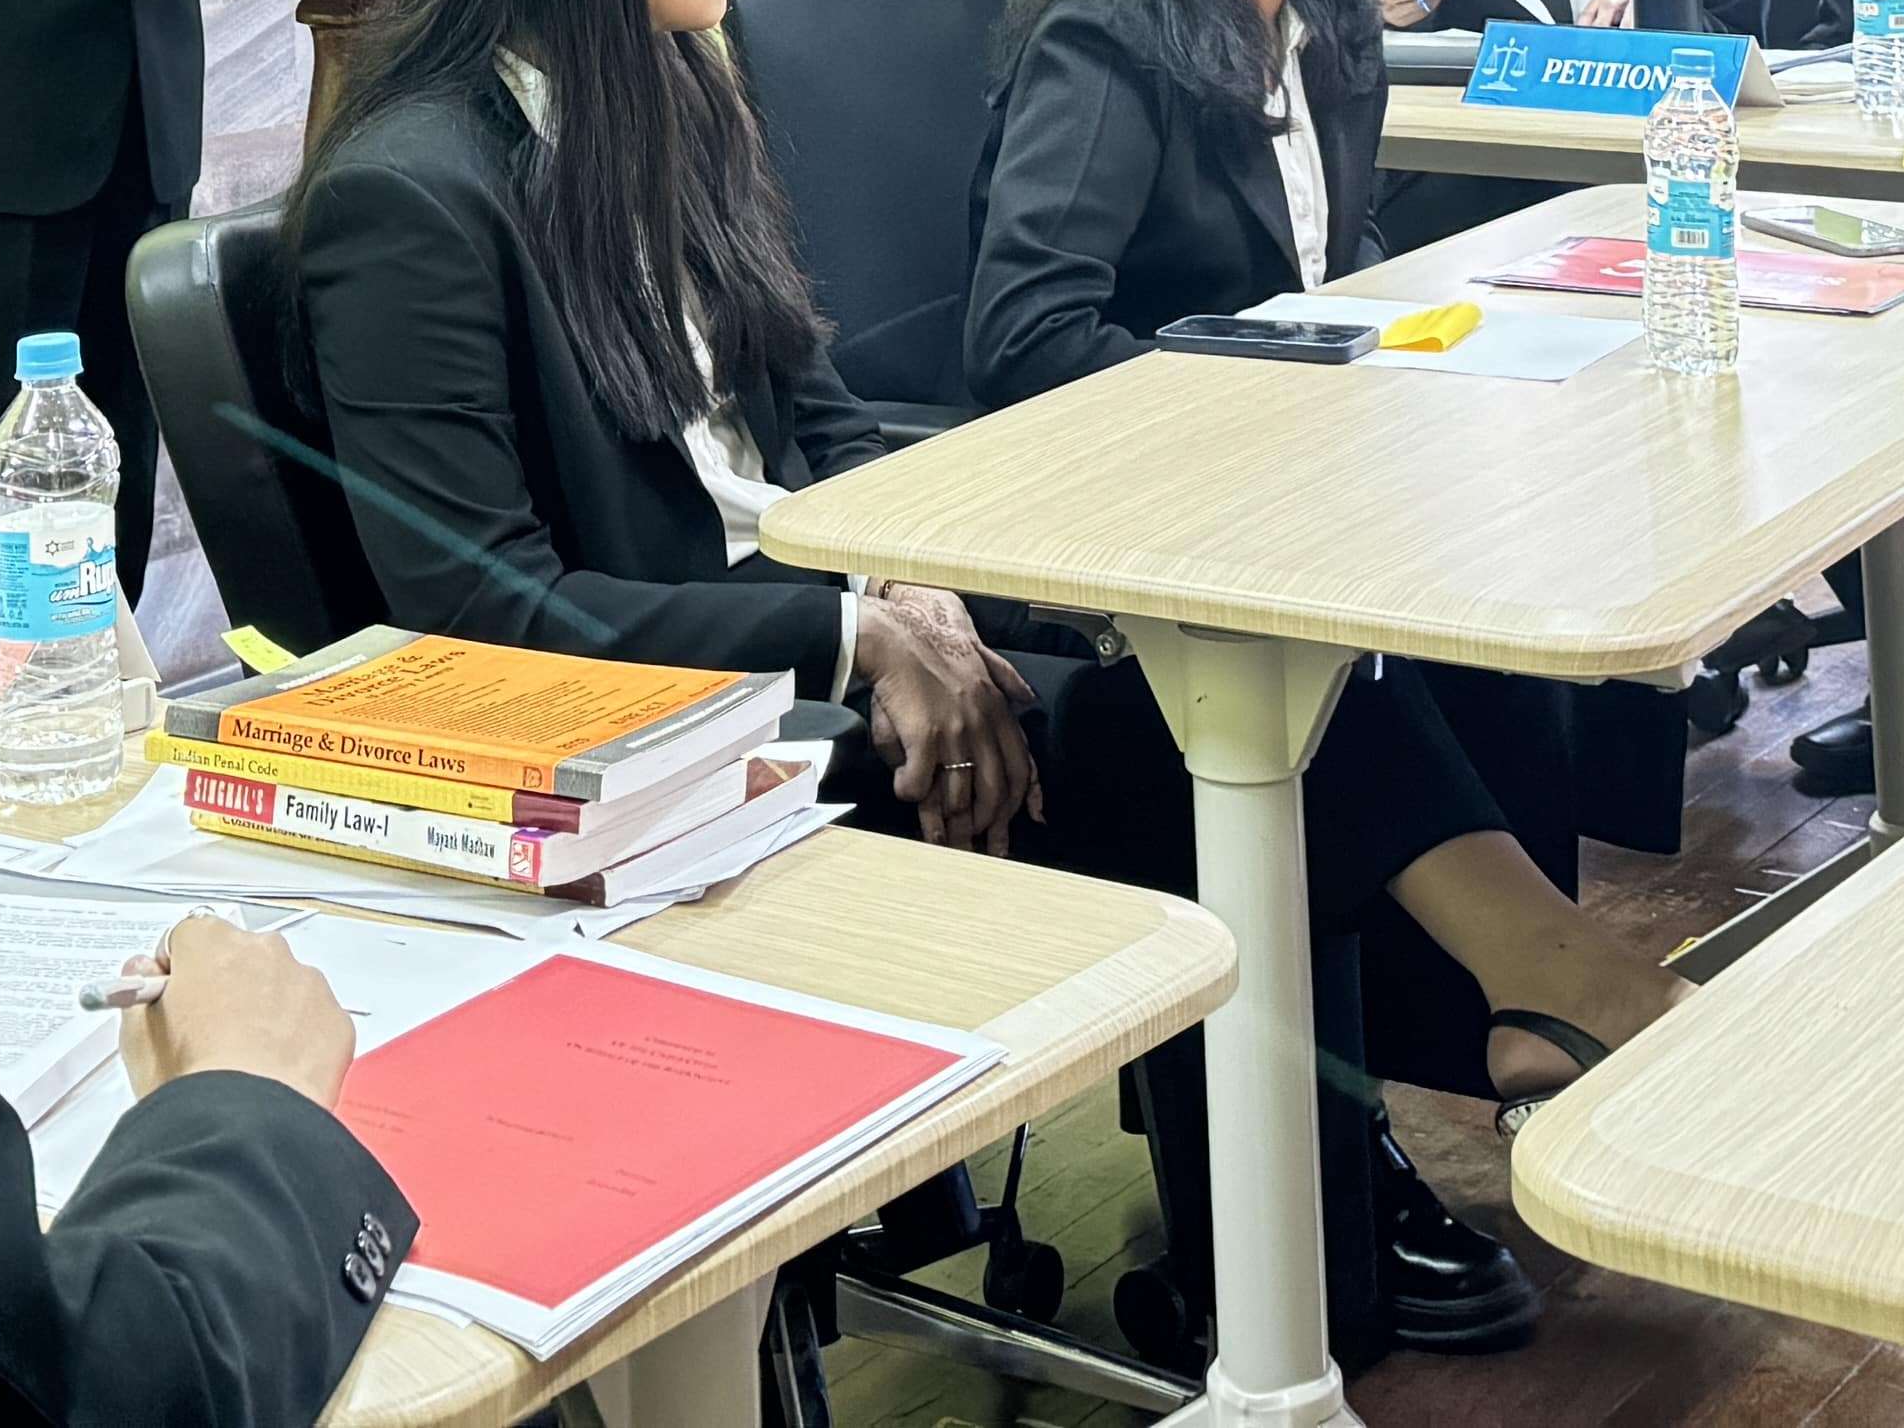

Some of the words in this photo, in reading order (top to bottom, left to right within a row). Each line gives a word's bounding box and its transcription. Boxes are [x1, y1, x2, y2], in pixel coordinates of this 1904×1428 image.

[1541, 58, 1674, 91] PETITION
[305, 676, 405, 707] Divorce
[401, 650, 467, 675] Laws
[173, 748, 210, 766] Indian
[214, 754, 244, 772] Penal
[248, 760, 279, 776] Code
[232, 719, 312, 752] Marriage
[319, 732, 334, 751] &
[340, 736, 411, 764] Divorce
[418, 749, 465, 773] Laws
[193, 775, 264, 815] SINGHAL'S
[286, 794, 338, 830] Family
